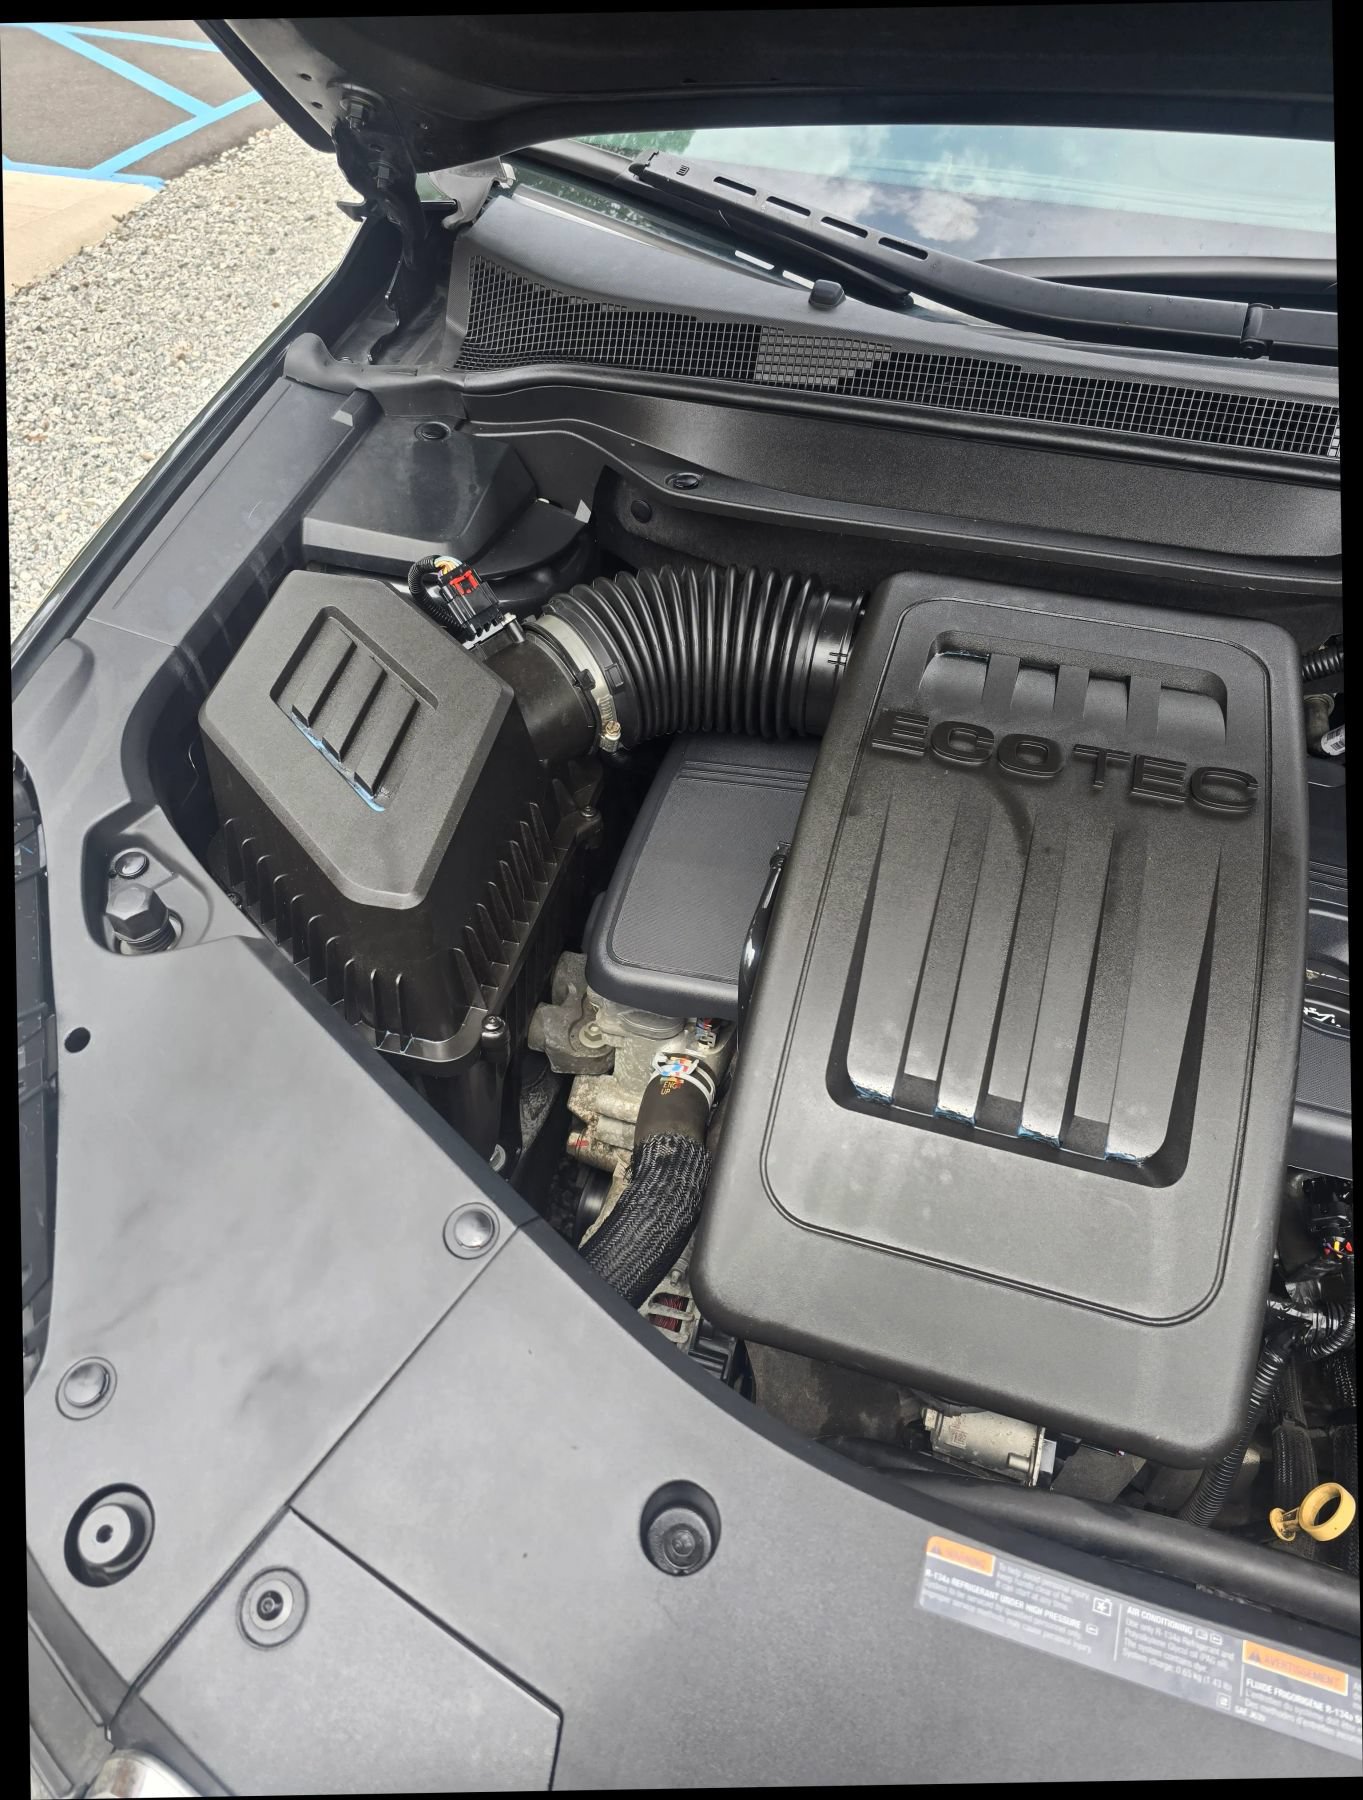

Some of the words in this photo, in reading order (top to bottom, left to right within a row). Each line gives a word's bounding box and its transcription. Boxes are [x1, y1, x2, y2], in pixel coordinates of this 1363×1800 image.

[871, 709, 1260, 814] ECOTEC
[951, 1577, 1000, 1601] REFRIGERANT
[1000, 1594, 1024, 1609] UNDER
[1026, 1603, 1043, 1615] HIGH
[1044, 1610, 1081, 1629] PRESSURE
[1127, 1606, 1140, 1617] AIR
[1141, 1611, 1193, 1634] CONDITIONING
